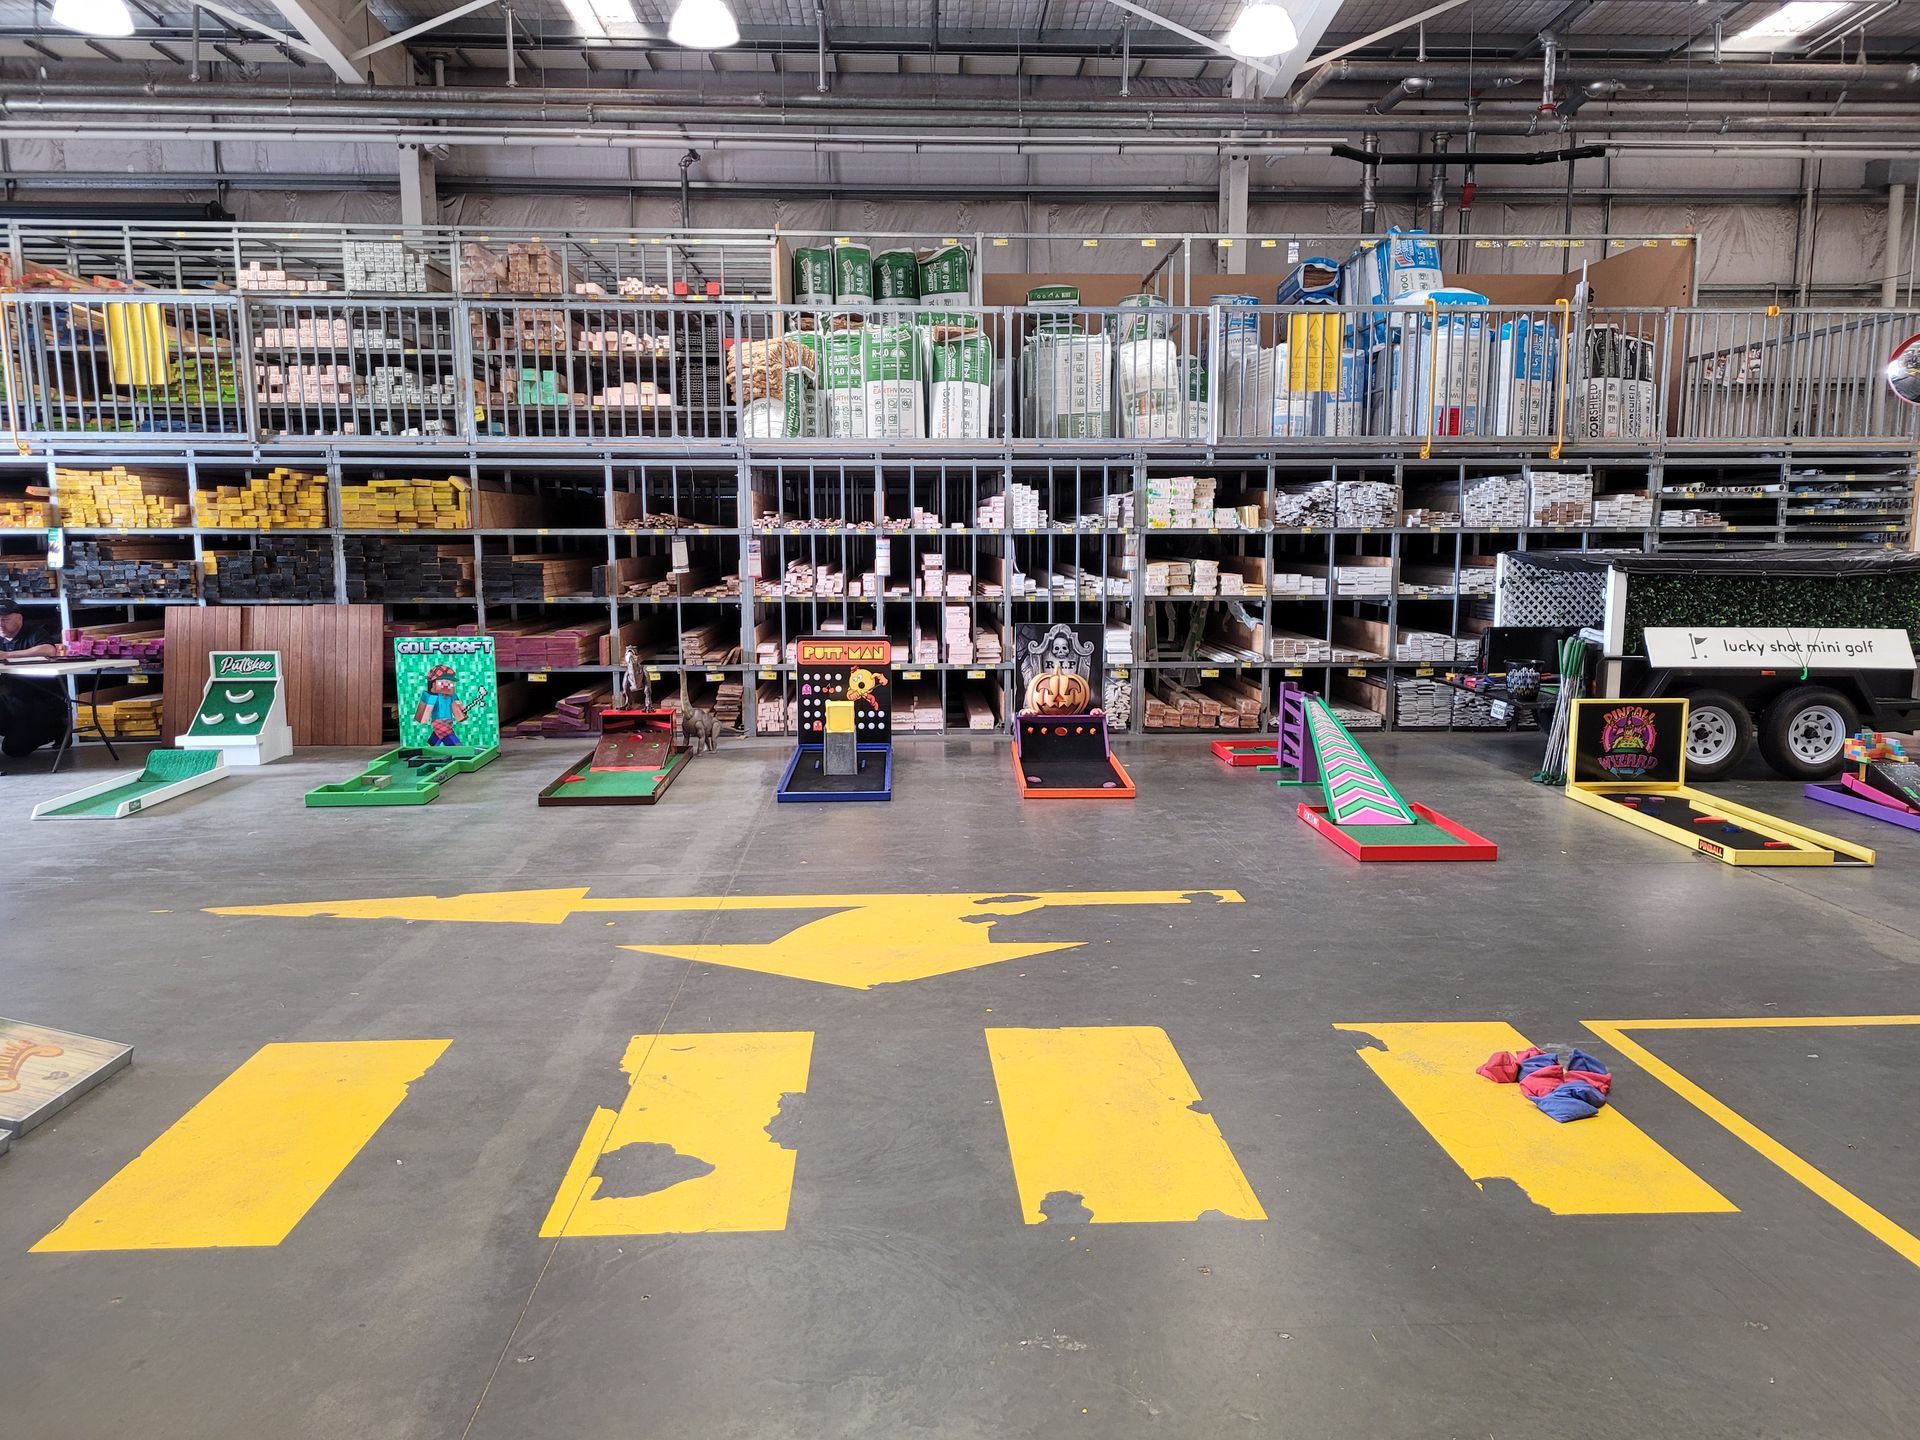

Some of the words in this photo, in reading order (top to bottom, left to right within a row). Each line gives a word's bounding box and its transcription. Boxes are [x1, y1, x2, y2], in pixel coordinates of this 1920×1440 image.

[397, 640, 492, 654] GOLFCRAFT
[1724, 639, 1765, 656] lucky
[1770, 640, 1802, 653] shot
[1806, 640, 1841, 654] mini
[1845, 640, 1875, 656] golf
[221, 656, 273, 675] Puttskee
[1603, 706, 1656, 724] PINBALL
[1597, 753, 1658, 770] WIZARD
[1700, 840, 1723, 857] PINBALL
